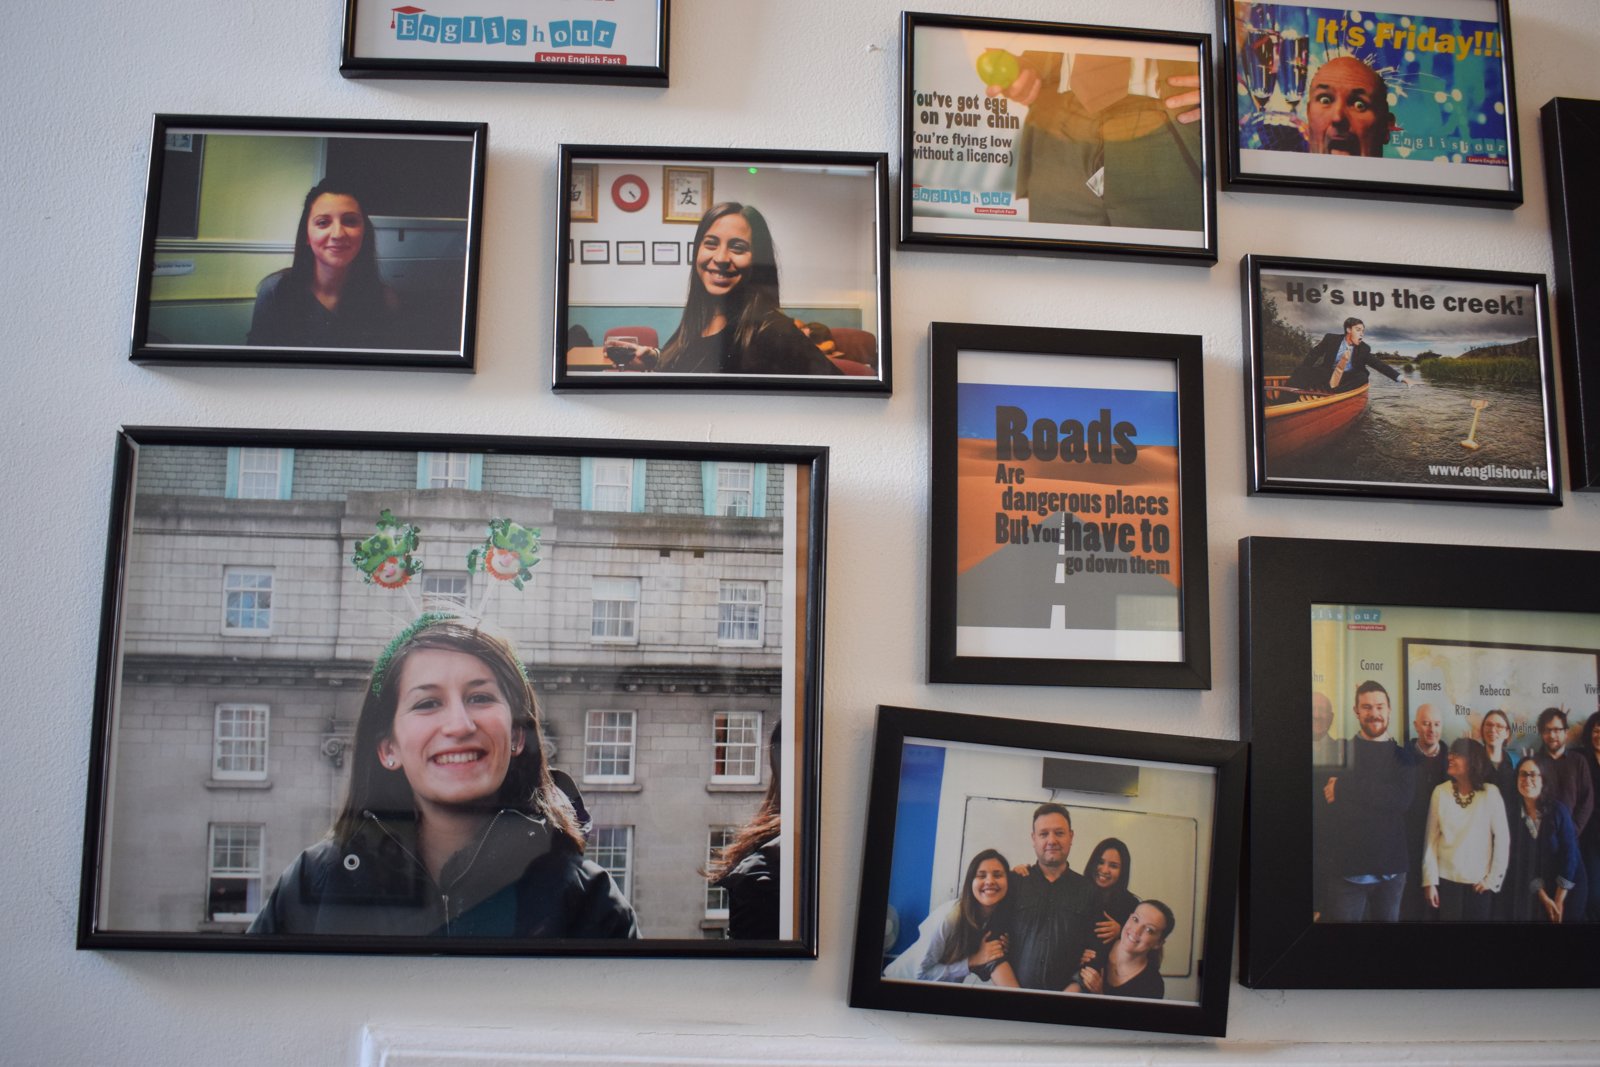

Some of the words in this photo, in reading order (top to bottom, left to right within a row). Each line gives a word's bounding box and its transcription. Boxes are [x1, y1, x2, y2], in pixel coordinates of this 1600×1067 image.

[1315, 18, 1366, 47] It's
[541, 54, 566, 63] Learn
[568, 55, 600, 64] English
[602, 57, 621, 65] Fast
[957, 94, 980, 112] got
[984, 96, 1008, 114] egg
[920, 110, 939, 125] on
[945, 112, 982, 129] your
[986, 113, 1020, 129] chin
[913, 131, 949, 145] ou're
[952, 133, 987, 149] flying
[990, 135, 1012, 147] low
[957, 151, 964, 161] a
[967, 149, 1014, 167] licence)
[1286, 282, 1345, 305] He's
[1353, 290, 1385, 311] up
[1392, 288, 1435, 311] the
[1443, 295, 1524, 316] creek!
[995, 405, 1138, 465] Roads
[995, 463, 1025, 484] Are
[1428, 464, 1548, 481] www.englishour.ie
[1001, 485, 1102, 516] dangerous
[1105, 489, 1169, 518] places
[995, 512, 1030, 544] But
[1031, 523, 1060, 543] You
[1065, 512, 1136, 553] have
[1141, 518, 1171, 553] to
[1065, 555, 1083, 575] go
[1085, 554, 1128, 574] down
[1130, 554, 1171, 575] them
[1416, 680, 1442, 692] James
[1479, 684, 1511, 697] Rebecca
[1455, 703, 1471, 716] Rita
